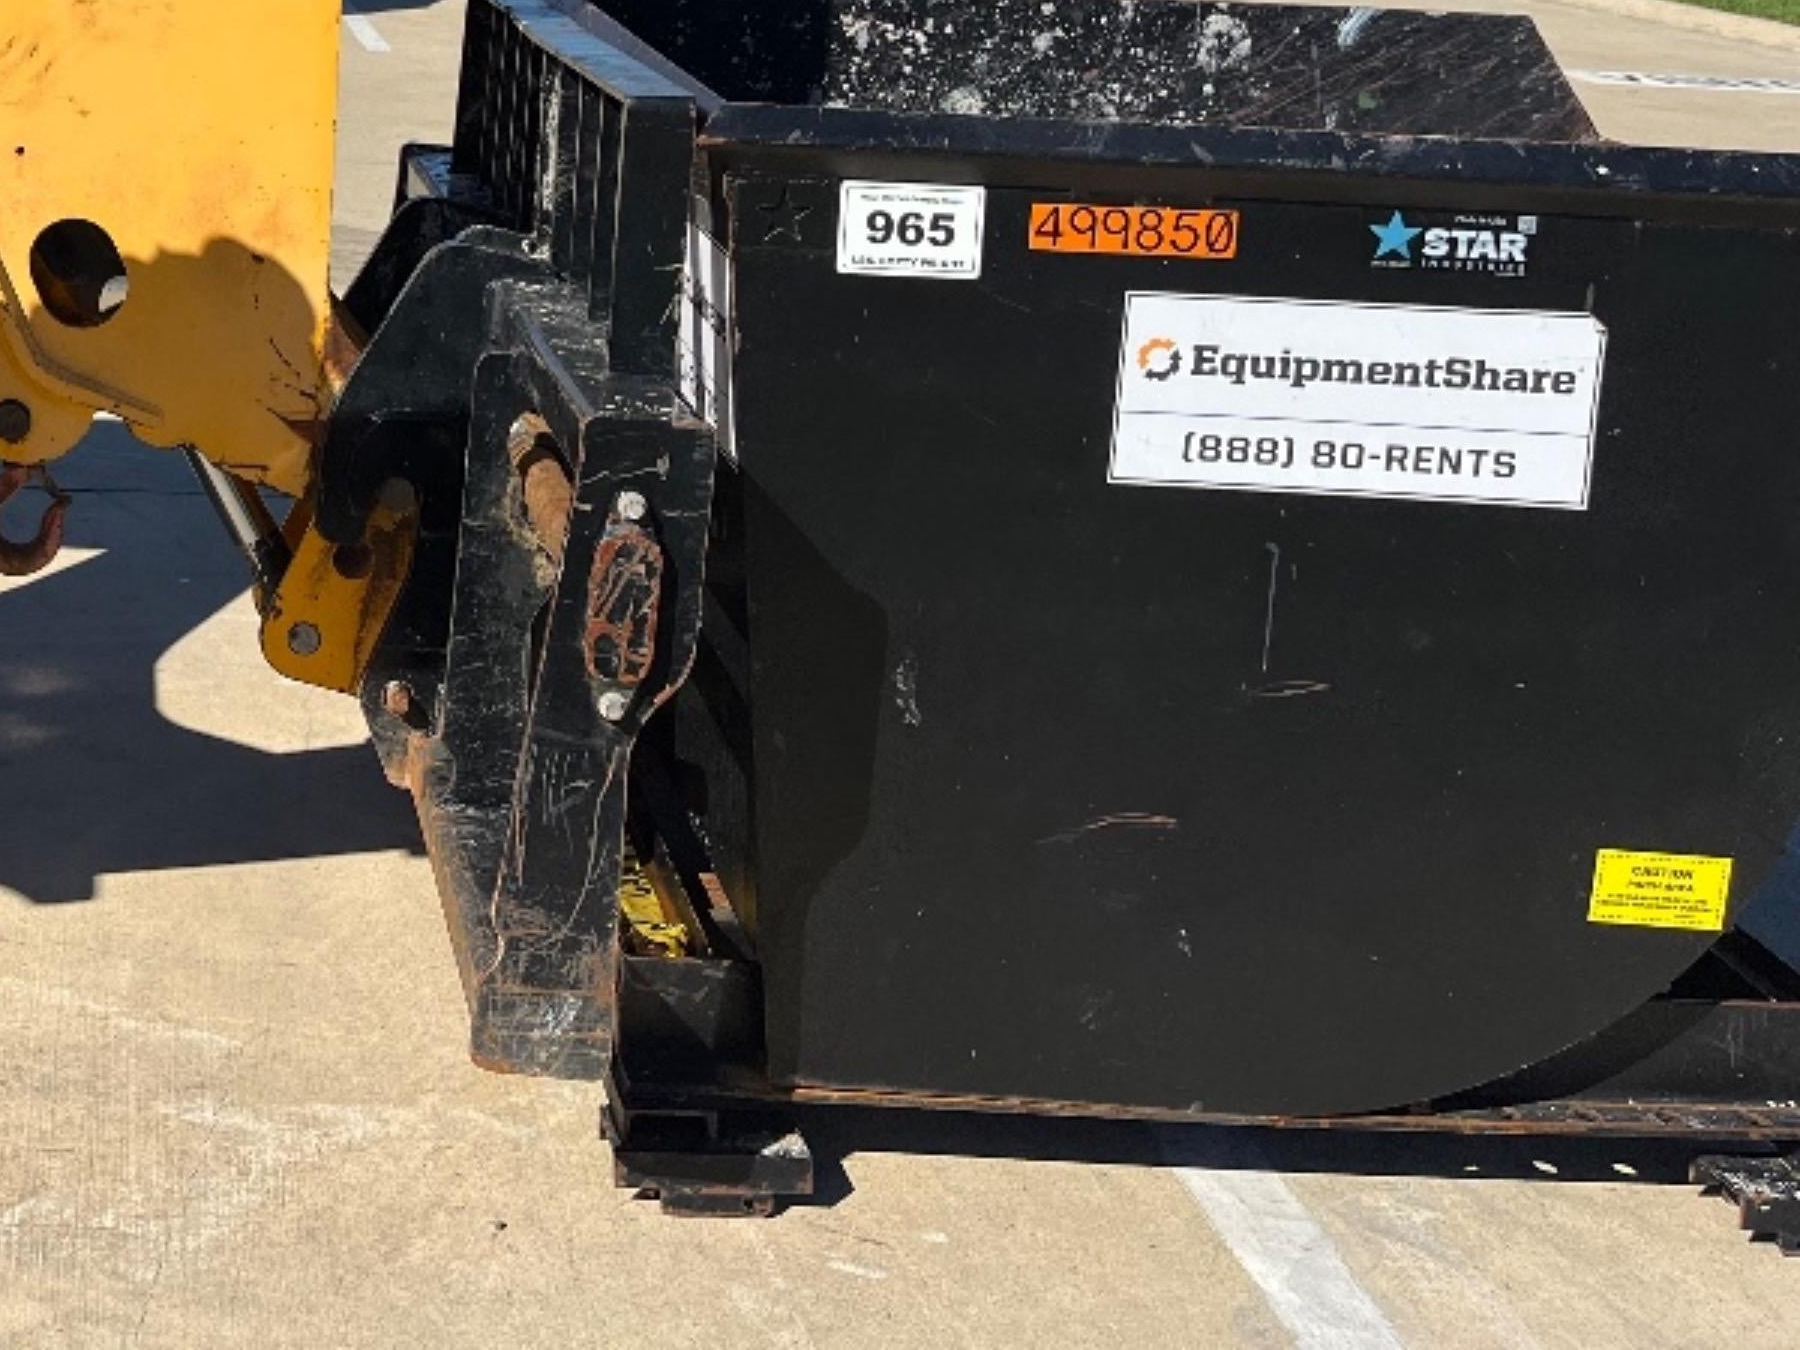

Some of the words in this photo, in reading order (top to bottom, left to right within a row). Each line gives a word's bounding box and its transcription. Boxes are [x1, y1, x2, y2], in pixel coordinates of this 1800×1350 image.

[865, 208, 956, 248] 965
[1033, 205, 1234, 254] 499850
[1421, 226, 1529, 262] STAR
[1190, 344, 1577, 396] EquipmentShare
[1181, 431, 1295, 469] (888)
[1310, 439, 1517, 479] 80-RENTS
